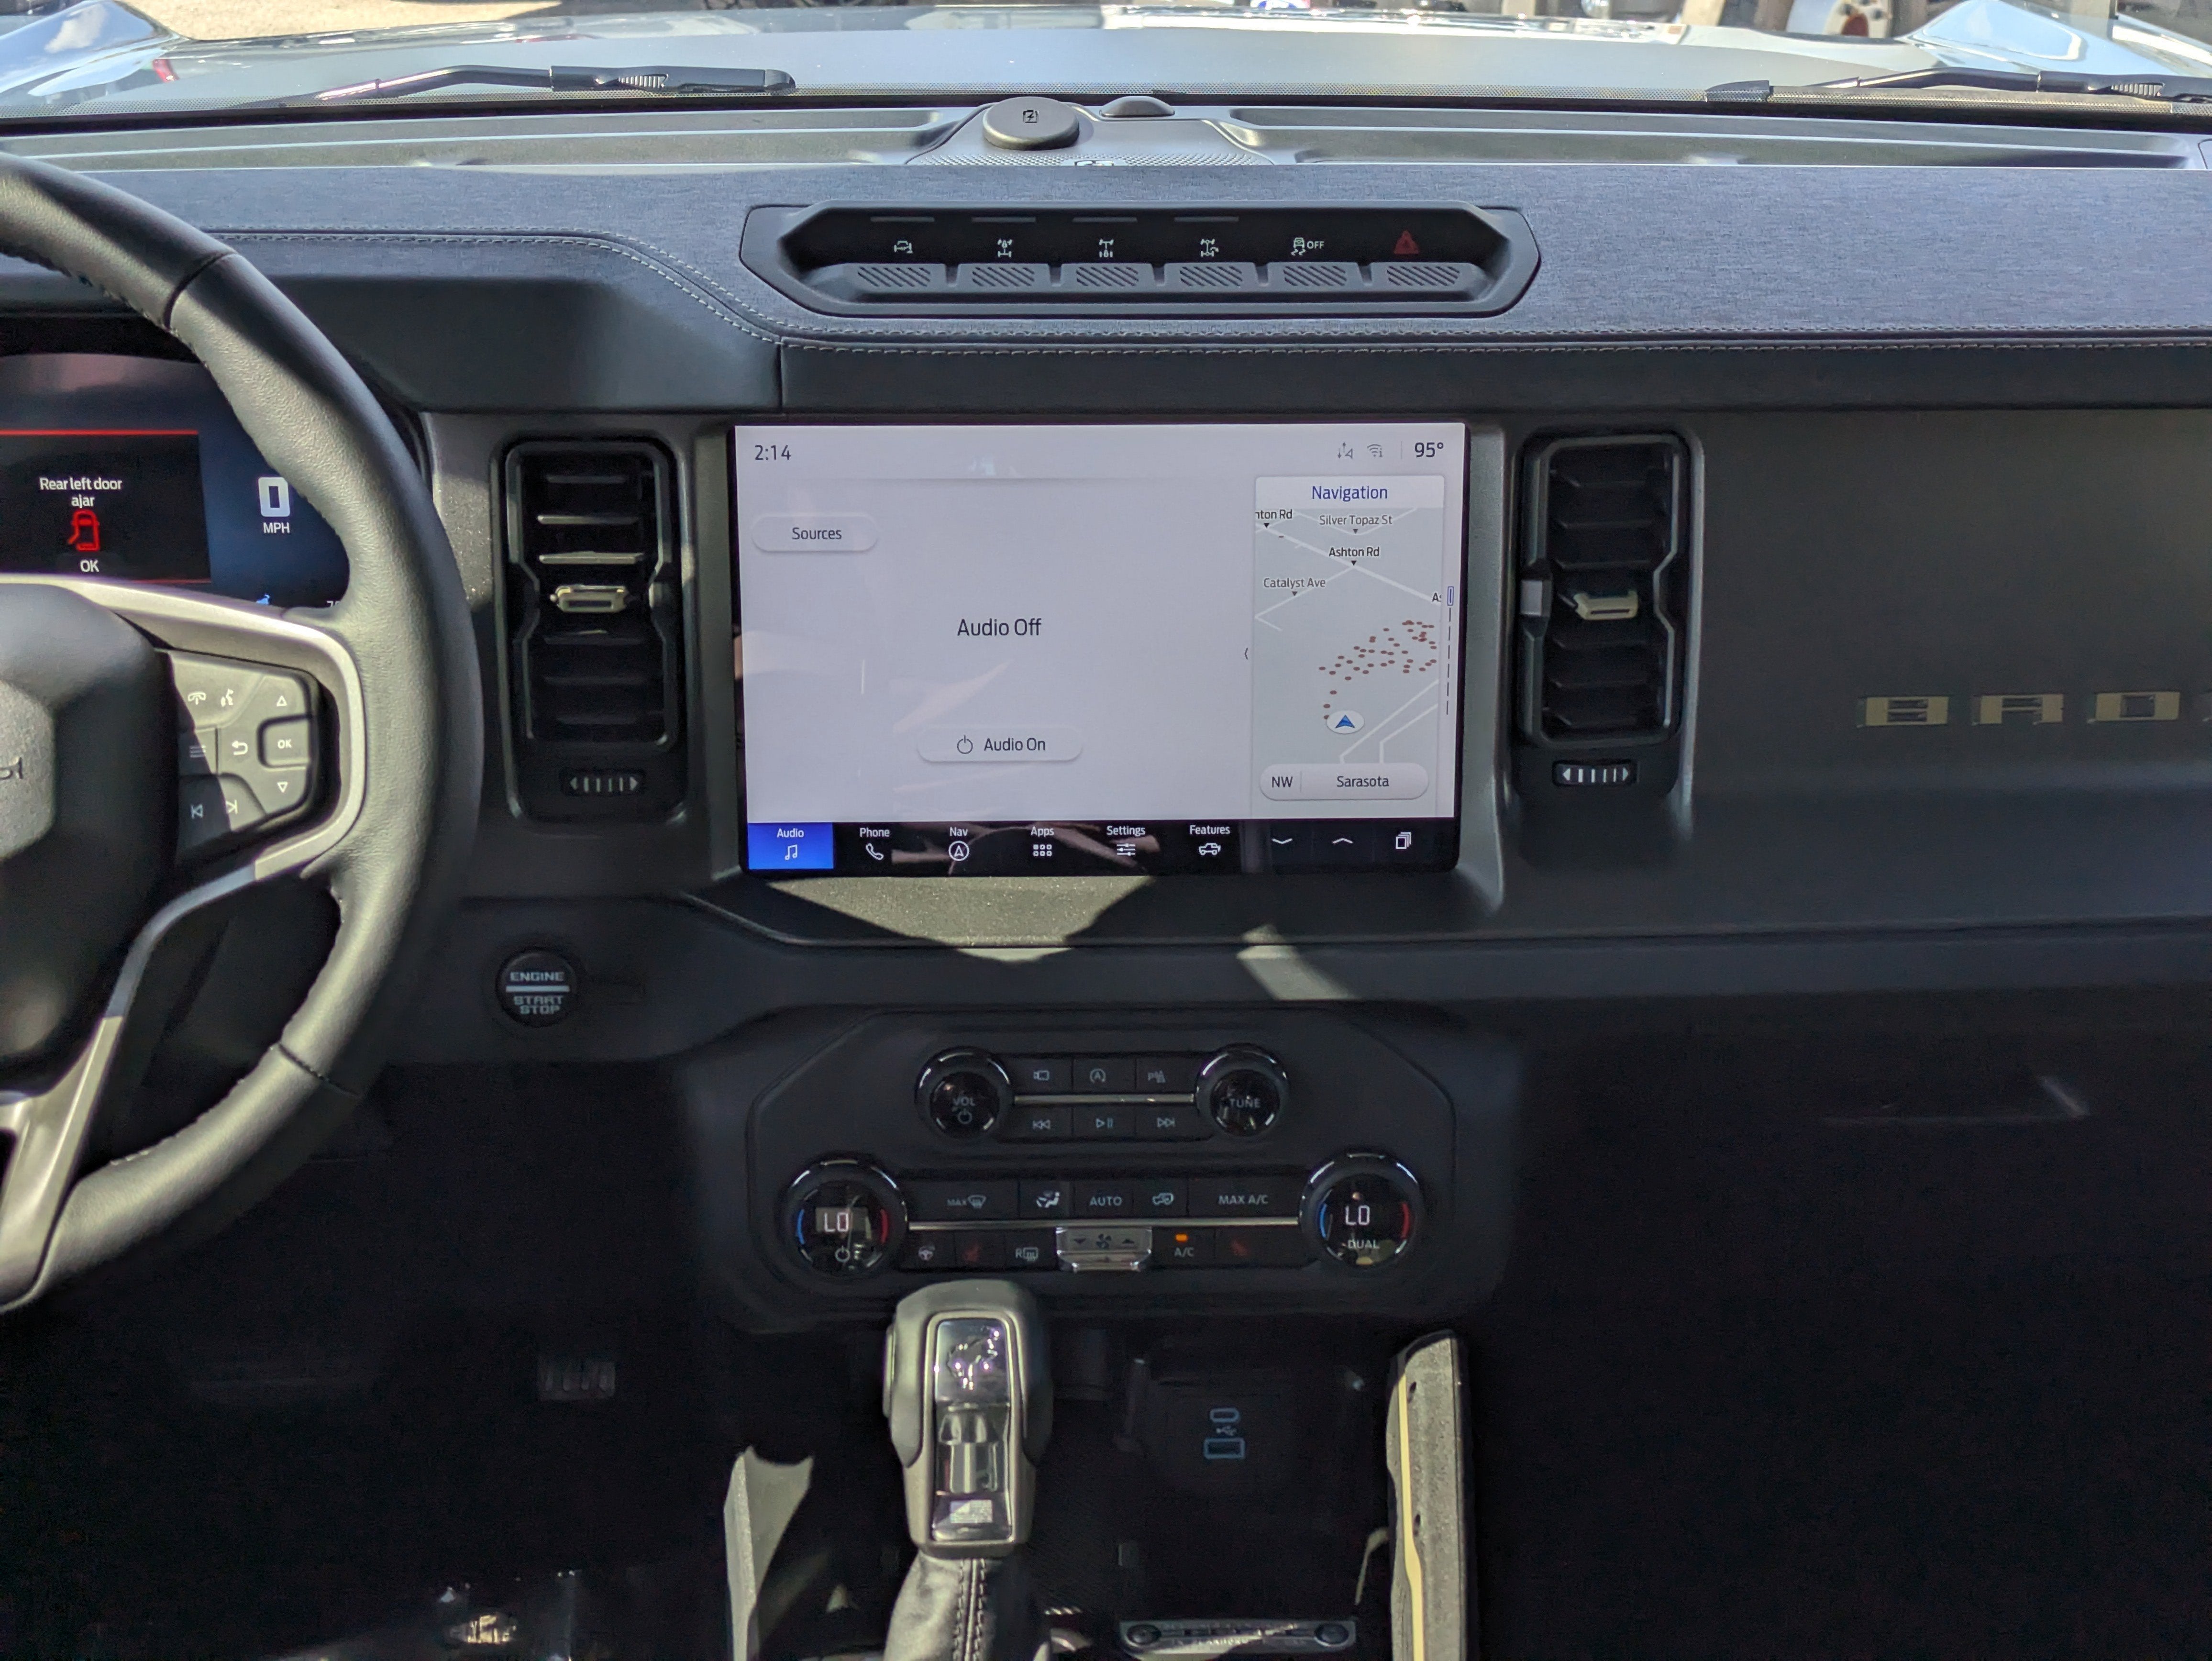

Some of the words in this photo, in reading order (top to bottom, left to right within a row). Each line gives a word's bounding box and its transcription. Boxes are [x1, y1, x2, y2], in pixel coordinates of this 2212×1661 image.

[1306, 241, 1325, 249] OFF
[754, 444, 792, 461] 2:14
[40, 477, 68, 490] Rear
[69, 477, 92, 490] left
[93, 477, 122, 490] door
[1311, 485, 1389, 502] Navigation
[72, 494, 95, 509] ajar
[1279, 509, 1293, 519] Rd
[1319, 515, 1347, 525] Silver
[1349, 515, 1380, 527] Topaz
[1381, 515, 1393, 525] St
[263, 522, 290, 534] MPH
[791, 527, 842, 541] Sources
[1329, 547, 1365, 557] Ashton
[1366, 546, 1380, 557] Rd
[80, 559, 100, 572] OK
[1263, 577, 1305, 589] Catalyst
[1307, 577, 1326, 587] Ave
[957, 617, 1009, 637] Audio
[1013, 617, 1042, 637] Off
[277, 739, 292, 749] OK
[984, 737, 1023, 753] Audio
[1026, 737, 1046, 753] On
[1271, 776, 1294, 788] NW
[1336, 775, 1390, 788] Sarasota
[776, 827, 805, 839] Audio
[859, 827, 890, 839] Phone
[949, 826, 968, 838] Nav
[1030, 825, 1055, 840] Apps
[1106, 824, 1146, 838] Settings
[1189, 823, 1231, 836] Features
[509, 971, 565, 981] ENGINE
[513, 995, 564, 1005] START
[520, 1005, 560, 1015] STOP
[952, 1096, 976, 1107] VOL
[1229, 1098, 1261, 1108] TUNE
[1089, 1196, 1122, 1207] AUTO
[1218, 1195, 1247, 1205] MAX
[1248, 1195, 1268, 1205] A/C
[1345, 1205, 1370, 1226] LO
[823, 1212, 849, 1233] LO
[1348, 1240, 1380, 1250] DUAL
[1174, 1247, 1194, 1258] A/C
